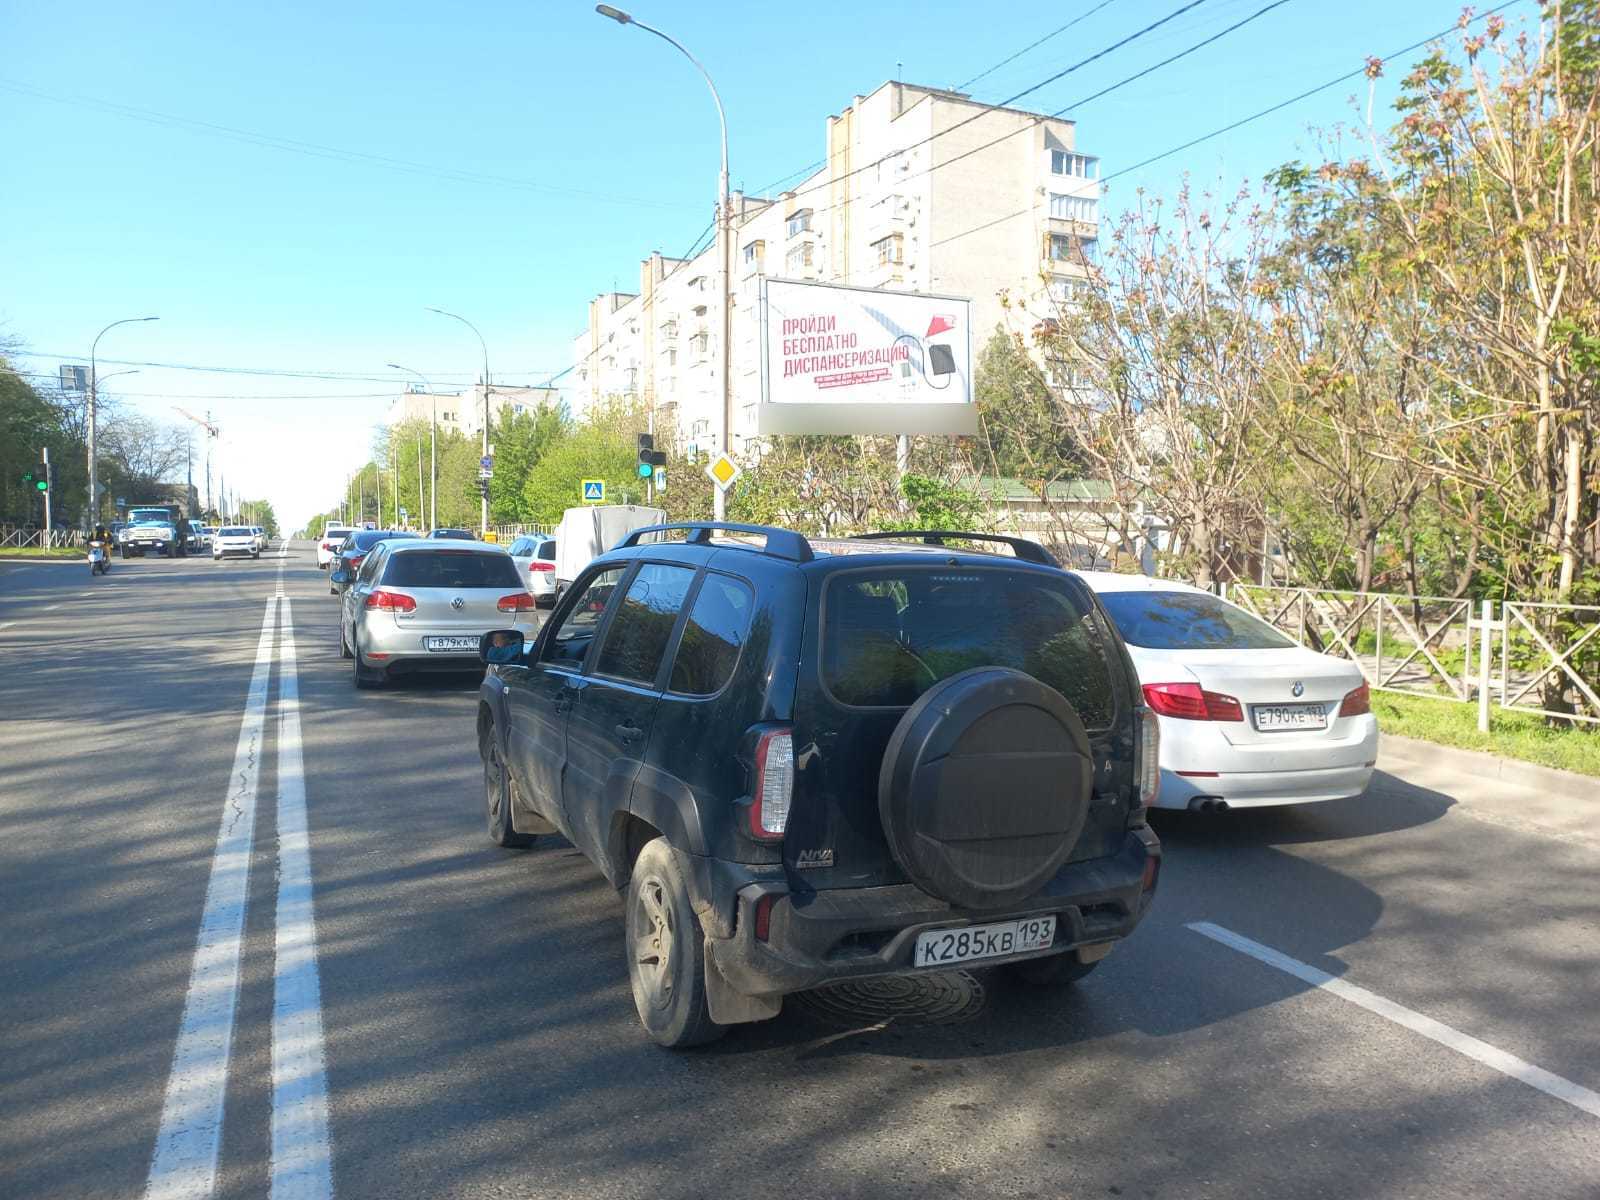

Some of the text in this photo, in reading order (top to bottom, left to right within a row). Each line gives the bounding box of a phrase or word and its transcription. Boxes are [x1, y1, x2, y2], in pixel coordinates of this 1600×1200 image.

[782, 314, 837, 337] ПРОЙДИ
[783, 332, 858, 356] БЕСПЛАТНО
[784, 344, 910, 379] ДИСПАНСЕРИЗАЦИЮ
[924, 919, 1052, 963] К285КВ 193
